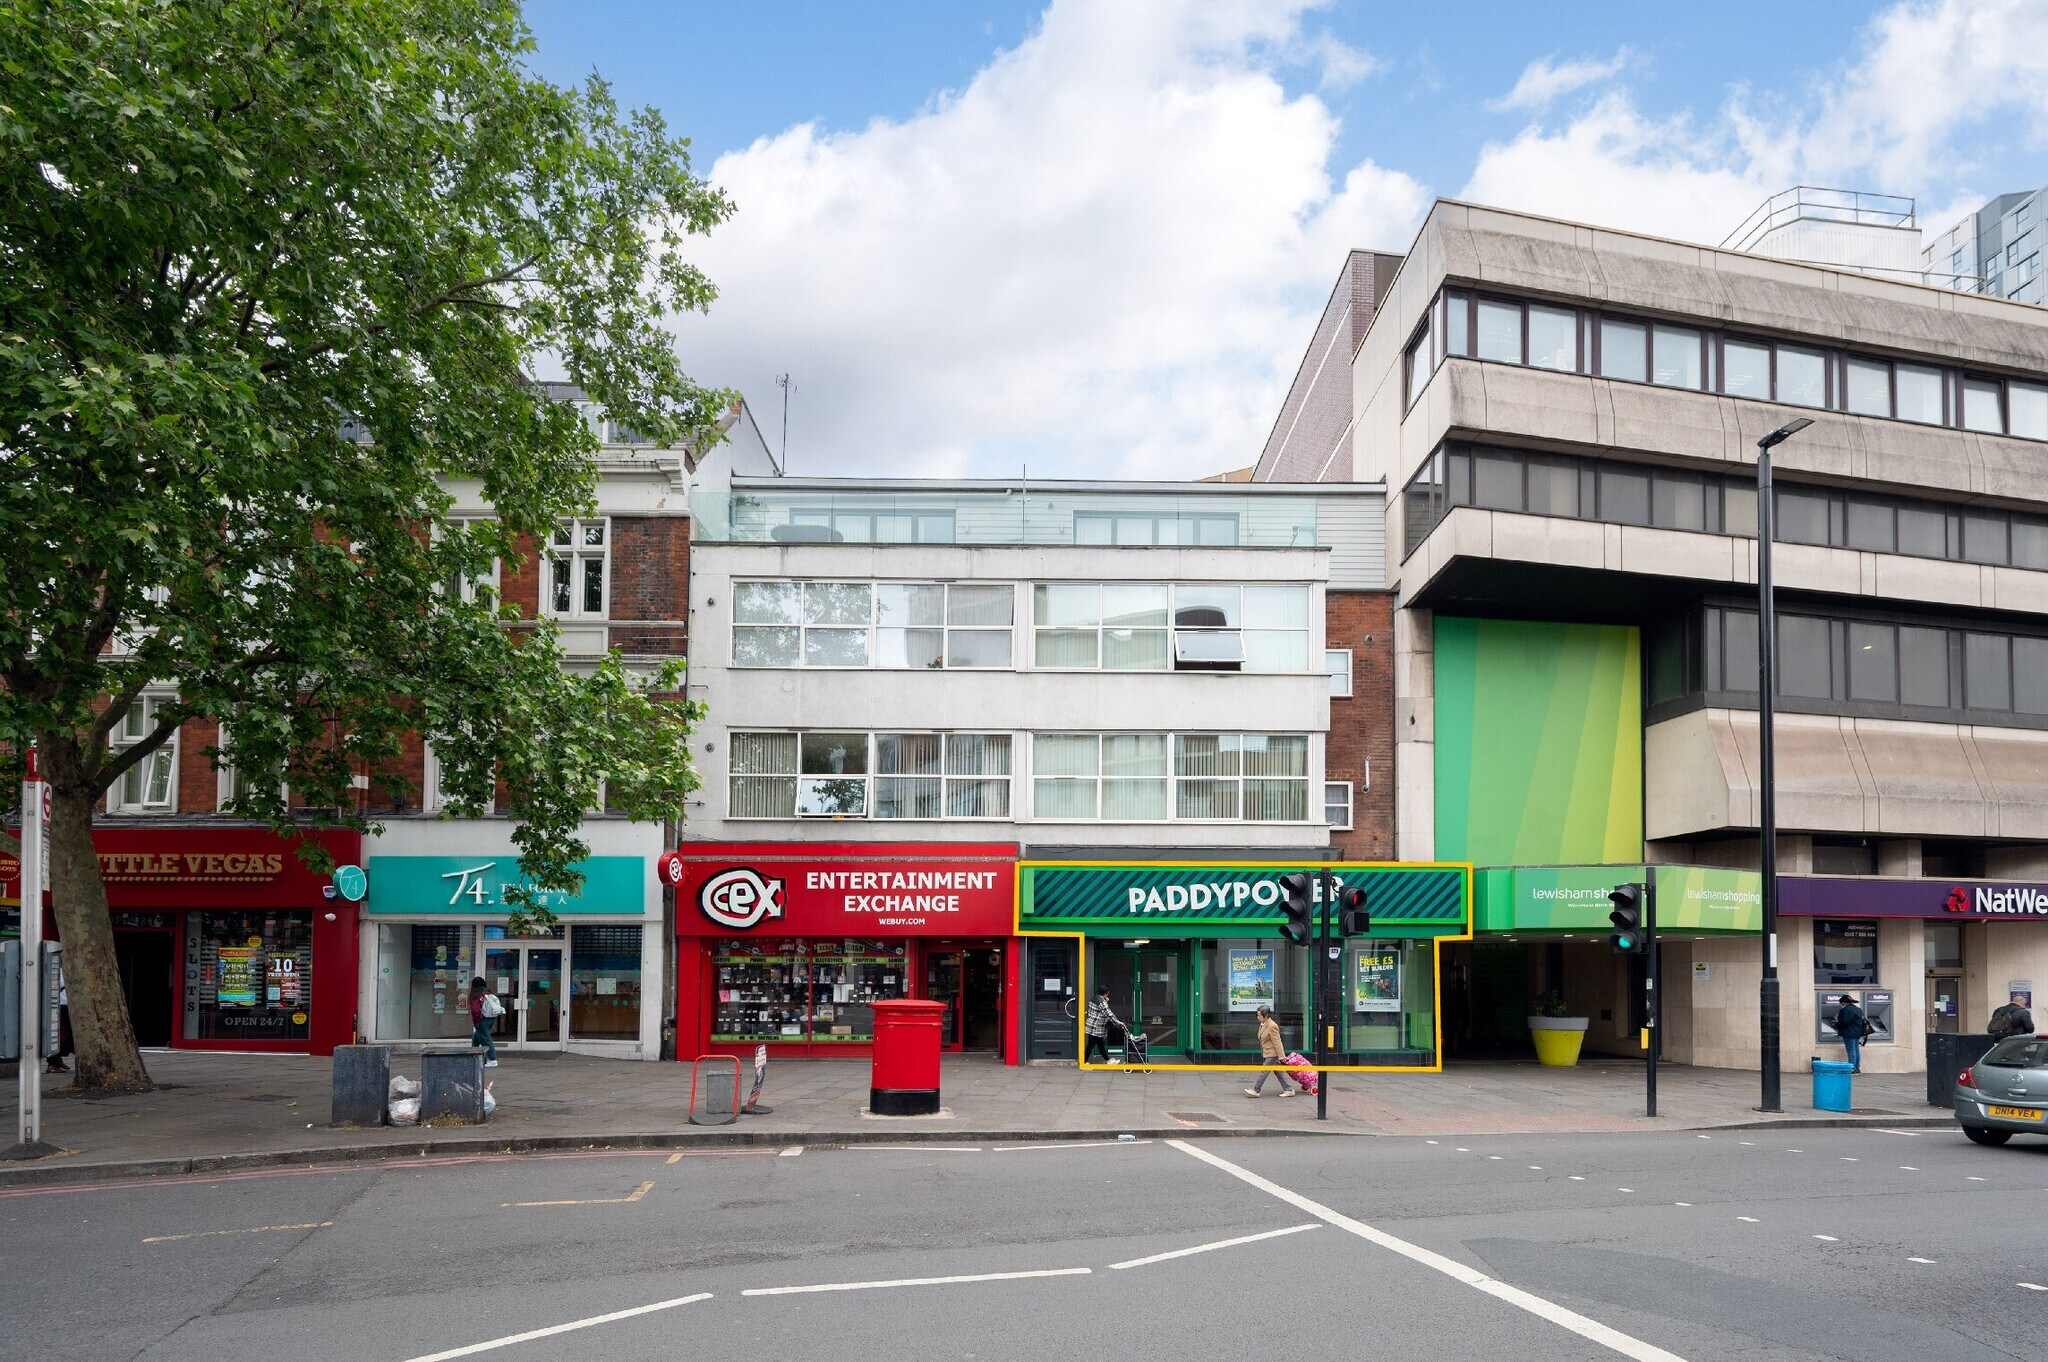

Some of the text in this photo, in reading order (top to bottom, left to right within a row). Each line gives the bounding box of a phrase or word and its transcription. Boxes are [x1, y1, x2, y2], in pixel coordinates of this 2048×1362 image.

[184, 854, 282, 874] VEGAS
[806, 872, 997, 890] ENTERTAINMENT
[844, 896, 959, 911] EXCHANGE
[274, 959, 293, 972] 10
[1360, 957, 1380, 966] FREE
[1383, 956, 1394, 965] £5
[188, 938, 198, 1012] SLOTS
[225, 1018, 257, 1026] OPEN
[260, 1018, 284, 1026] 24/7
[1995, 1107, 2036, 1119] DN14 VEA
